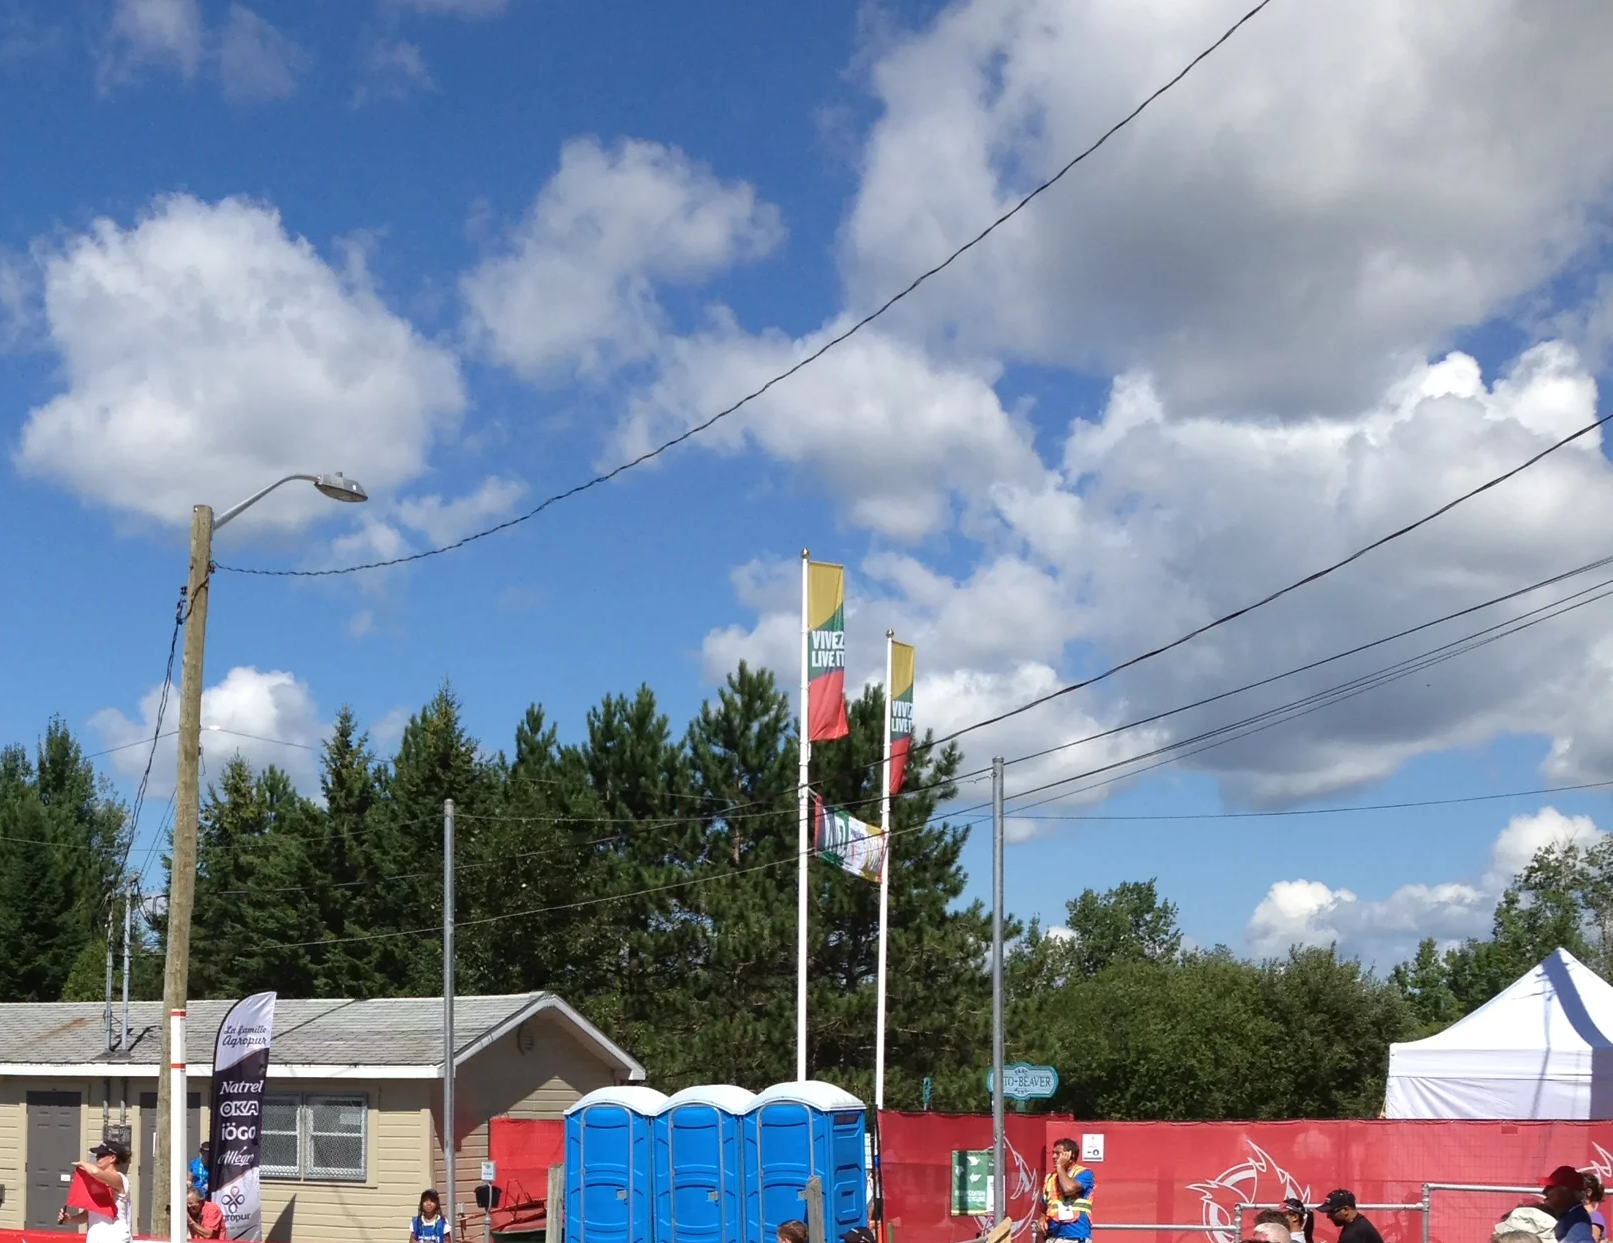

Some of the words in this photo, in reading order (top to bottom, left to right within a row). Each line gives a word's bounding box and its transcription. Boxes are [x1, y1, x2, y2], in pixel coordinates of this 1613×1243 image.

[811, 630, 845, 650] VIVEZ
[811, 650, 834, 668] LIVE
[836, 650, 845, 668] IT
[891, 717, 907, 733] LIVE
[224, 1025, 237, 1035] La
[238, 1024, 267, 1035] famille
[222, 1034, 268, 1047] Agropur
[220, 1080, 265, 1096] Natrel
[1004, 1076, 1051, 1088] TO-BEAVER
[220, 1100, 259, 1117] OKA
[223, 1213, 251, 1223] gropur
